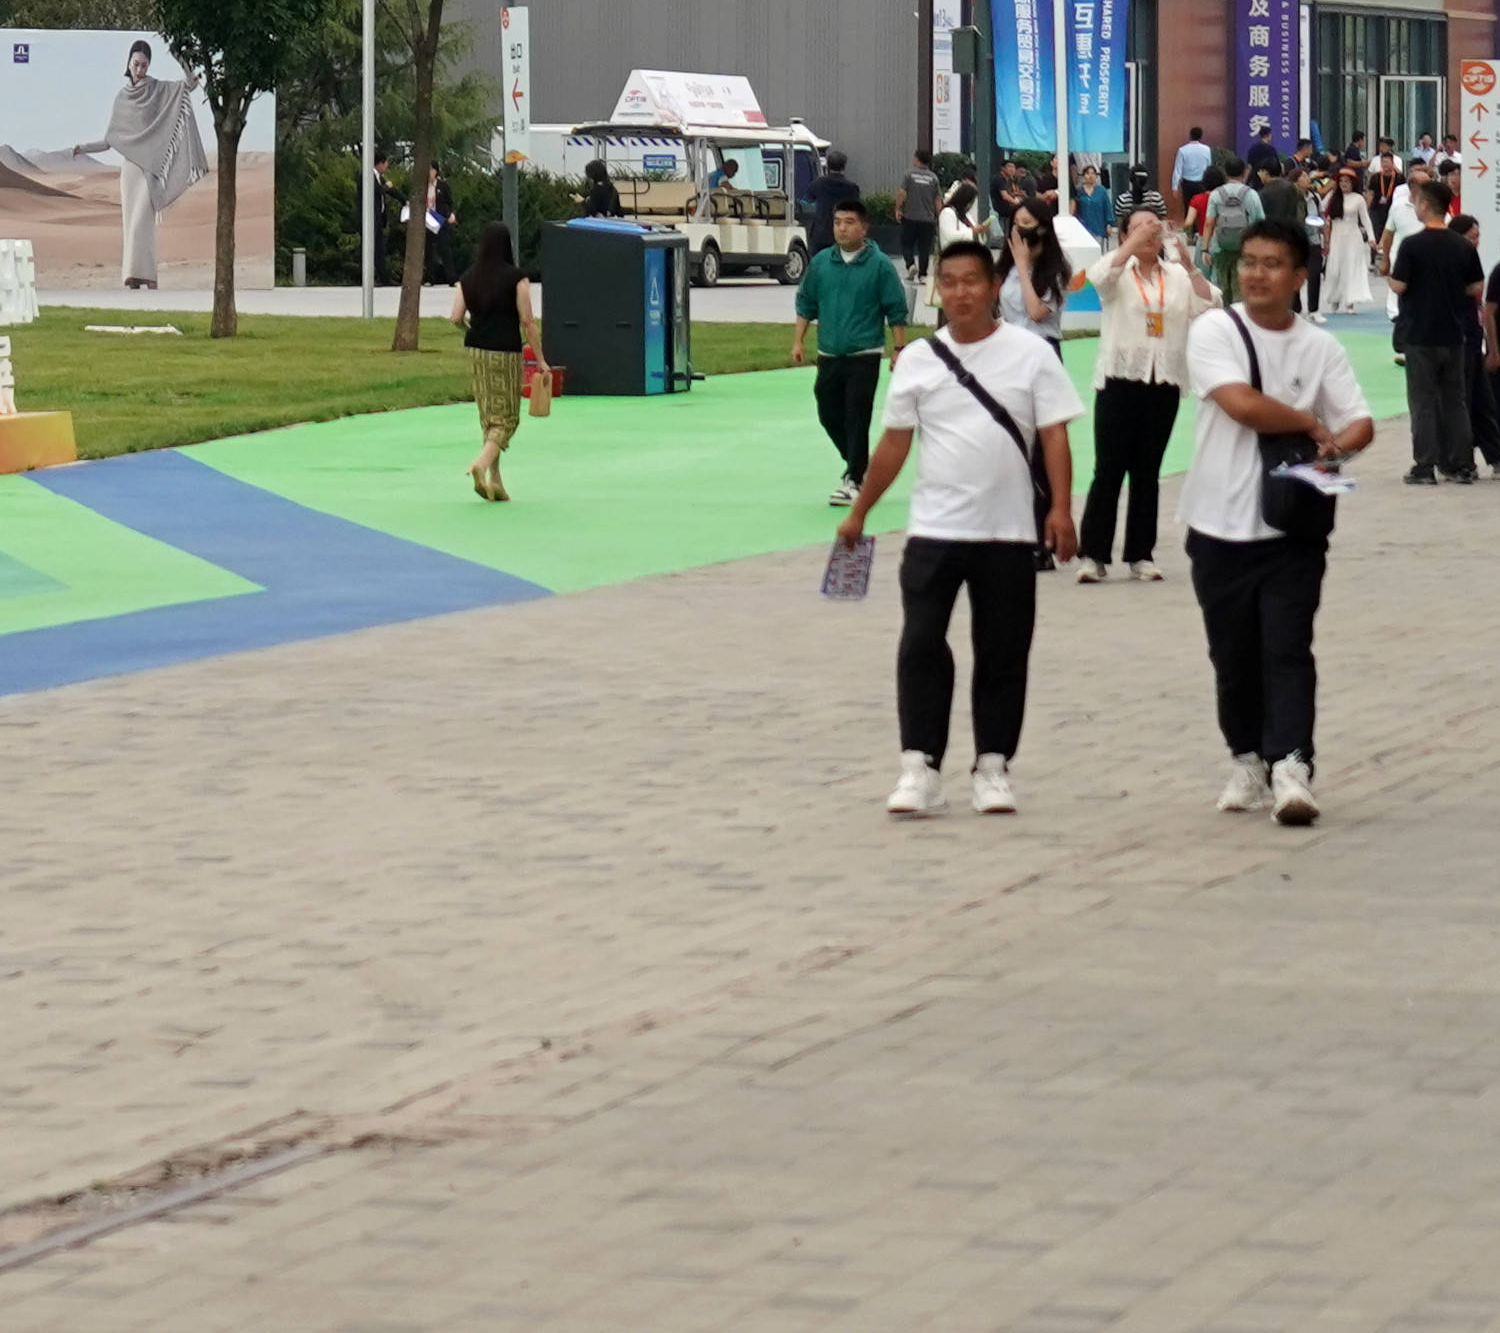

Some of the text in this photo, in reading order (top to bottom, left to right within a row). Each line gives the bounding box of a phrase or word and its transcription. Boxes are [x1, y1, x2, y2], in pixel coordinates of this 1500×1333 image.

[1280, 14, 1289, 75] BUSINESS
[1098, 46, 1111, 118] PROSPERITY
[1281, 79, 1289, 139] SERVICES
